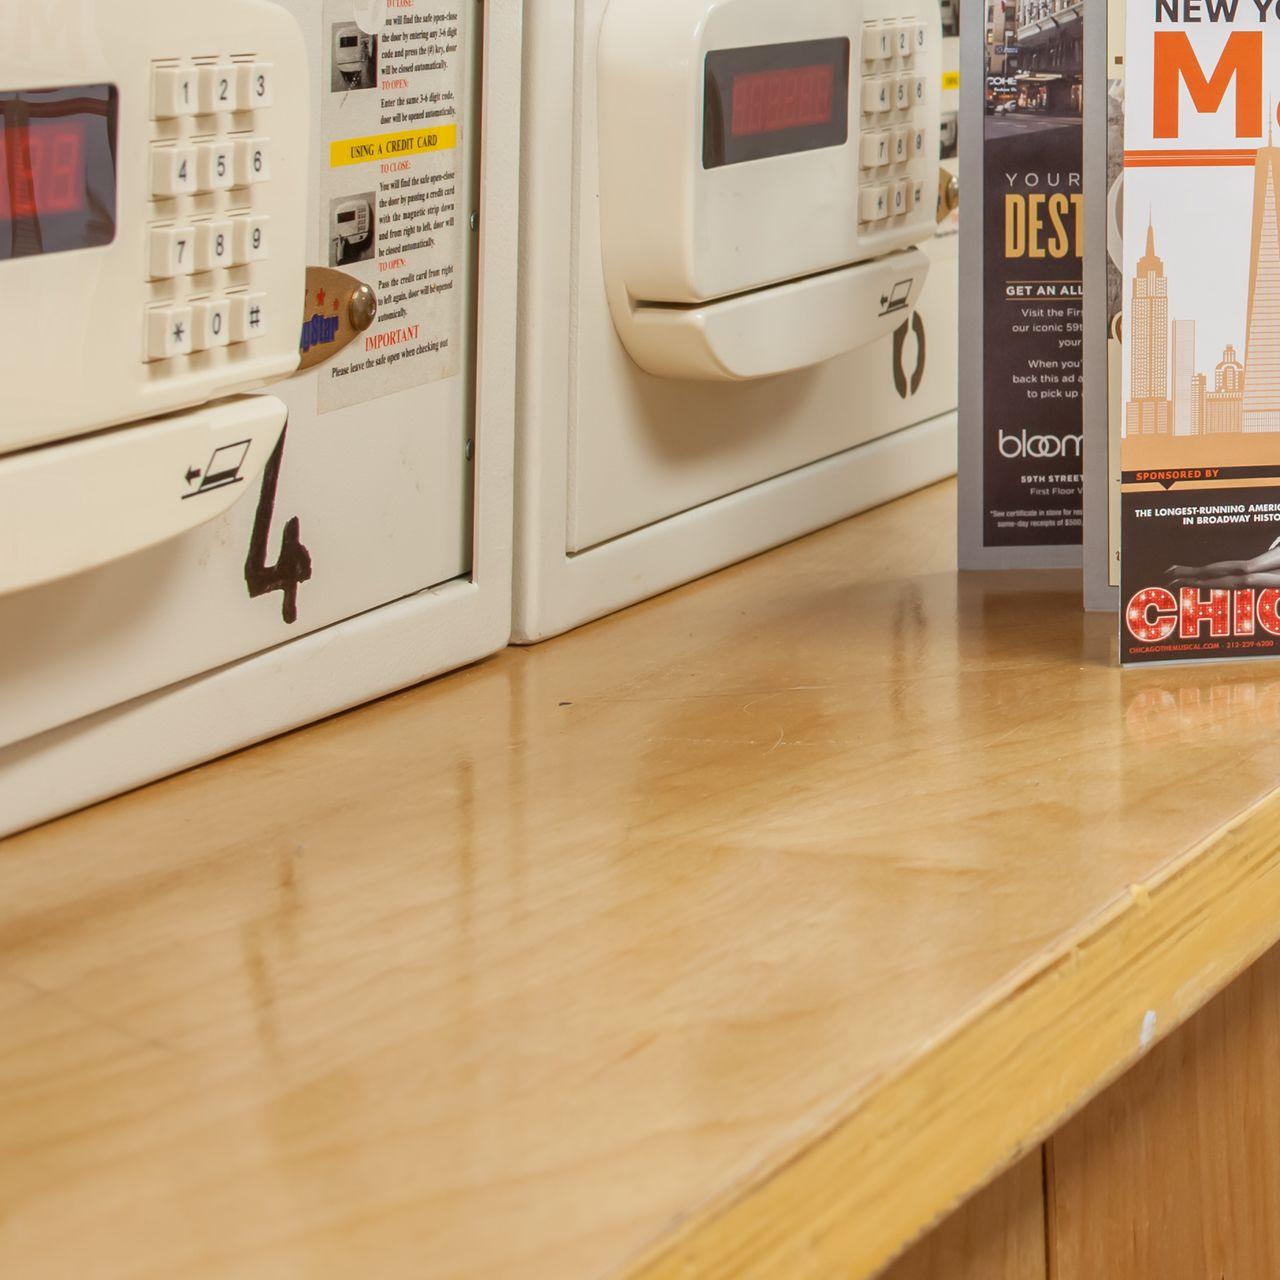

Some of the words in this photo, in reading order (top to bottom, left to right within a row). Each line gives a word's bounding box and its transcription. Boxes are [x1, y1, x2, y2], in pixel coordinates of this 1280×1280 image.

[183, 82, 190, 104] 1
[219, 80, 228, 101] 2
[256, 74, 265, 96] 3
[351, 142, 374, 158] USING
[378, 143, 383, 154] A
[386, 138, 414, 153] CREDIT
[417, 134, 438, 147] CARD
[178, 159, 187, 182] 4
[217, 155, 225, 177] 5
[253, 151, 262, 172] 6
[1005, 173, 1080, 187] YOUR
[1005, 193, 1083, 258] DEST
[177, 241, 186, 263] 7
[216, 234, 225, 256] 8
[252, 228, 261, 249] 9
[1006, 286, 1032, 296] GET
[1037, 286, 1056, 295] AN
[1021, 309, 1044, 317] Visit
[1047, 308, 1064, 317] the
[1067, 308, 1083, 316] Fir
[212, 313, 221, 335] 0
[1012, 325, 1029, 333] our
[1033, 324, 1063, 332] iconic
[365, 324, 419, 353] IMPORTANT
[1059, 339, 1081, 348] your
[331, 367, 349, 378] Please
[350, 362, 365, 373] leave
[366, 358, 375, 369] the
[375, 355, 386, 367] safe
[387, 352, 400, 364] open
[401, 348, 415, 358] when
[416, 340, 439, 355] checking
[439, 338, 448, 348] out
[1028, 360, 1058, 368] When
[1013, 375, 1037, 384] back
[1040, 375, 1059, 383] this
[1062, 375, 1074, 383] ad
[1027, 390, 1037, 398] to
[1041, 390, 1062, 399] pick
[1065, 391, 1078, 399] up
[1021, 475, 1045, 483] 59TH
[1049, 474, 1083, 482] STREET
[1136, 470, 1202, 481] SPONSORED
[1205, 469, 1220, 478] BY
[1135, 509, 1152, 518] THE
[1154, 505, 1246, 517] LONGEST-RUNNING
[244, 418, 312, 624] 4
[1183, 517, 1194, 526] IN
[1197, 515, 1251, 525] BROADWAY
[1129, 642, 1220, 654] CHICAGOTHEMUSICAL.COM
